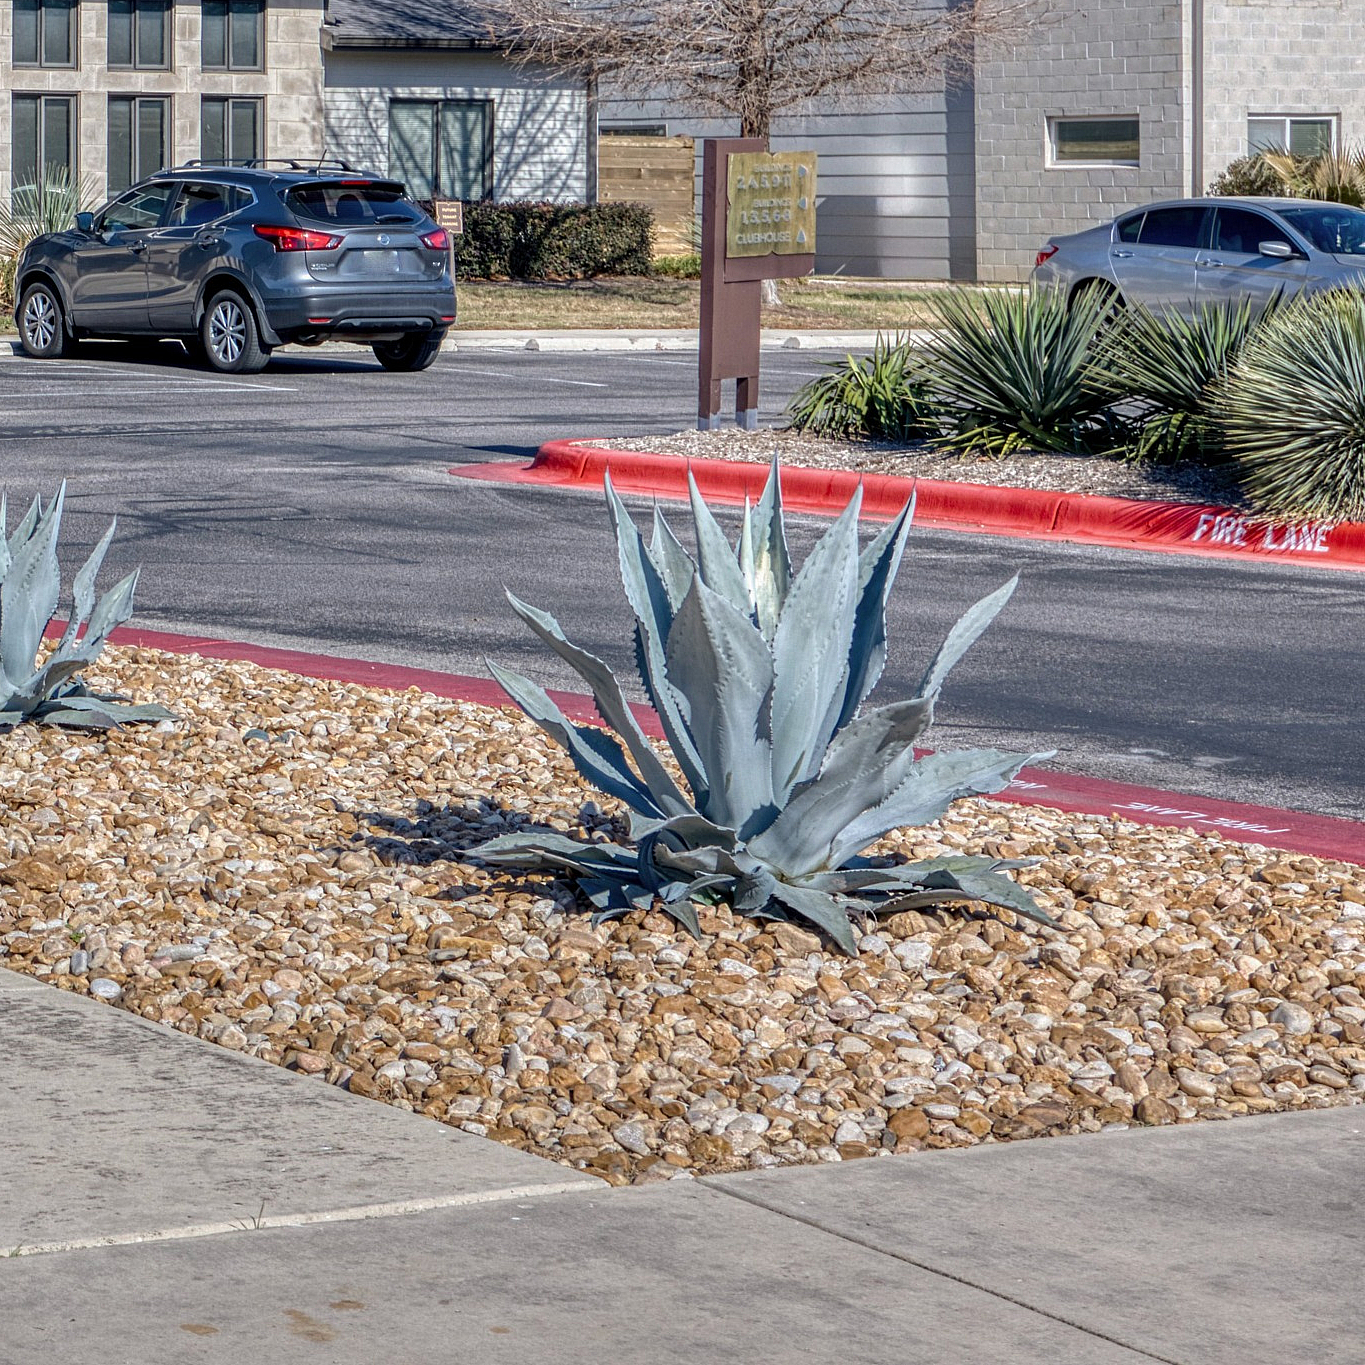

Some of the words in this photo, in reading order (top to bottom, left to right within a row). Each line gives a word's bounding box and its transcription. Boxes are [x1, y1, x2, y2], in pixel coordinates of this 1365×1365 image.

[736, 231, 791, 245] CLUBHOUSE
[1191, 514, 1252, 547] FIRE
[1262, 523, 1334, 553] LANE
[1111, 801, 1209, 819] LANE
[1199, 817, 1291, 834] FIRE
